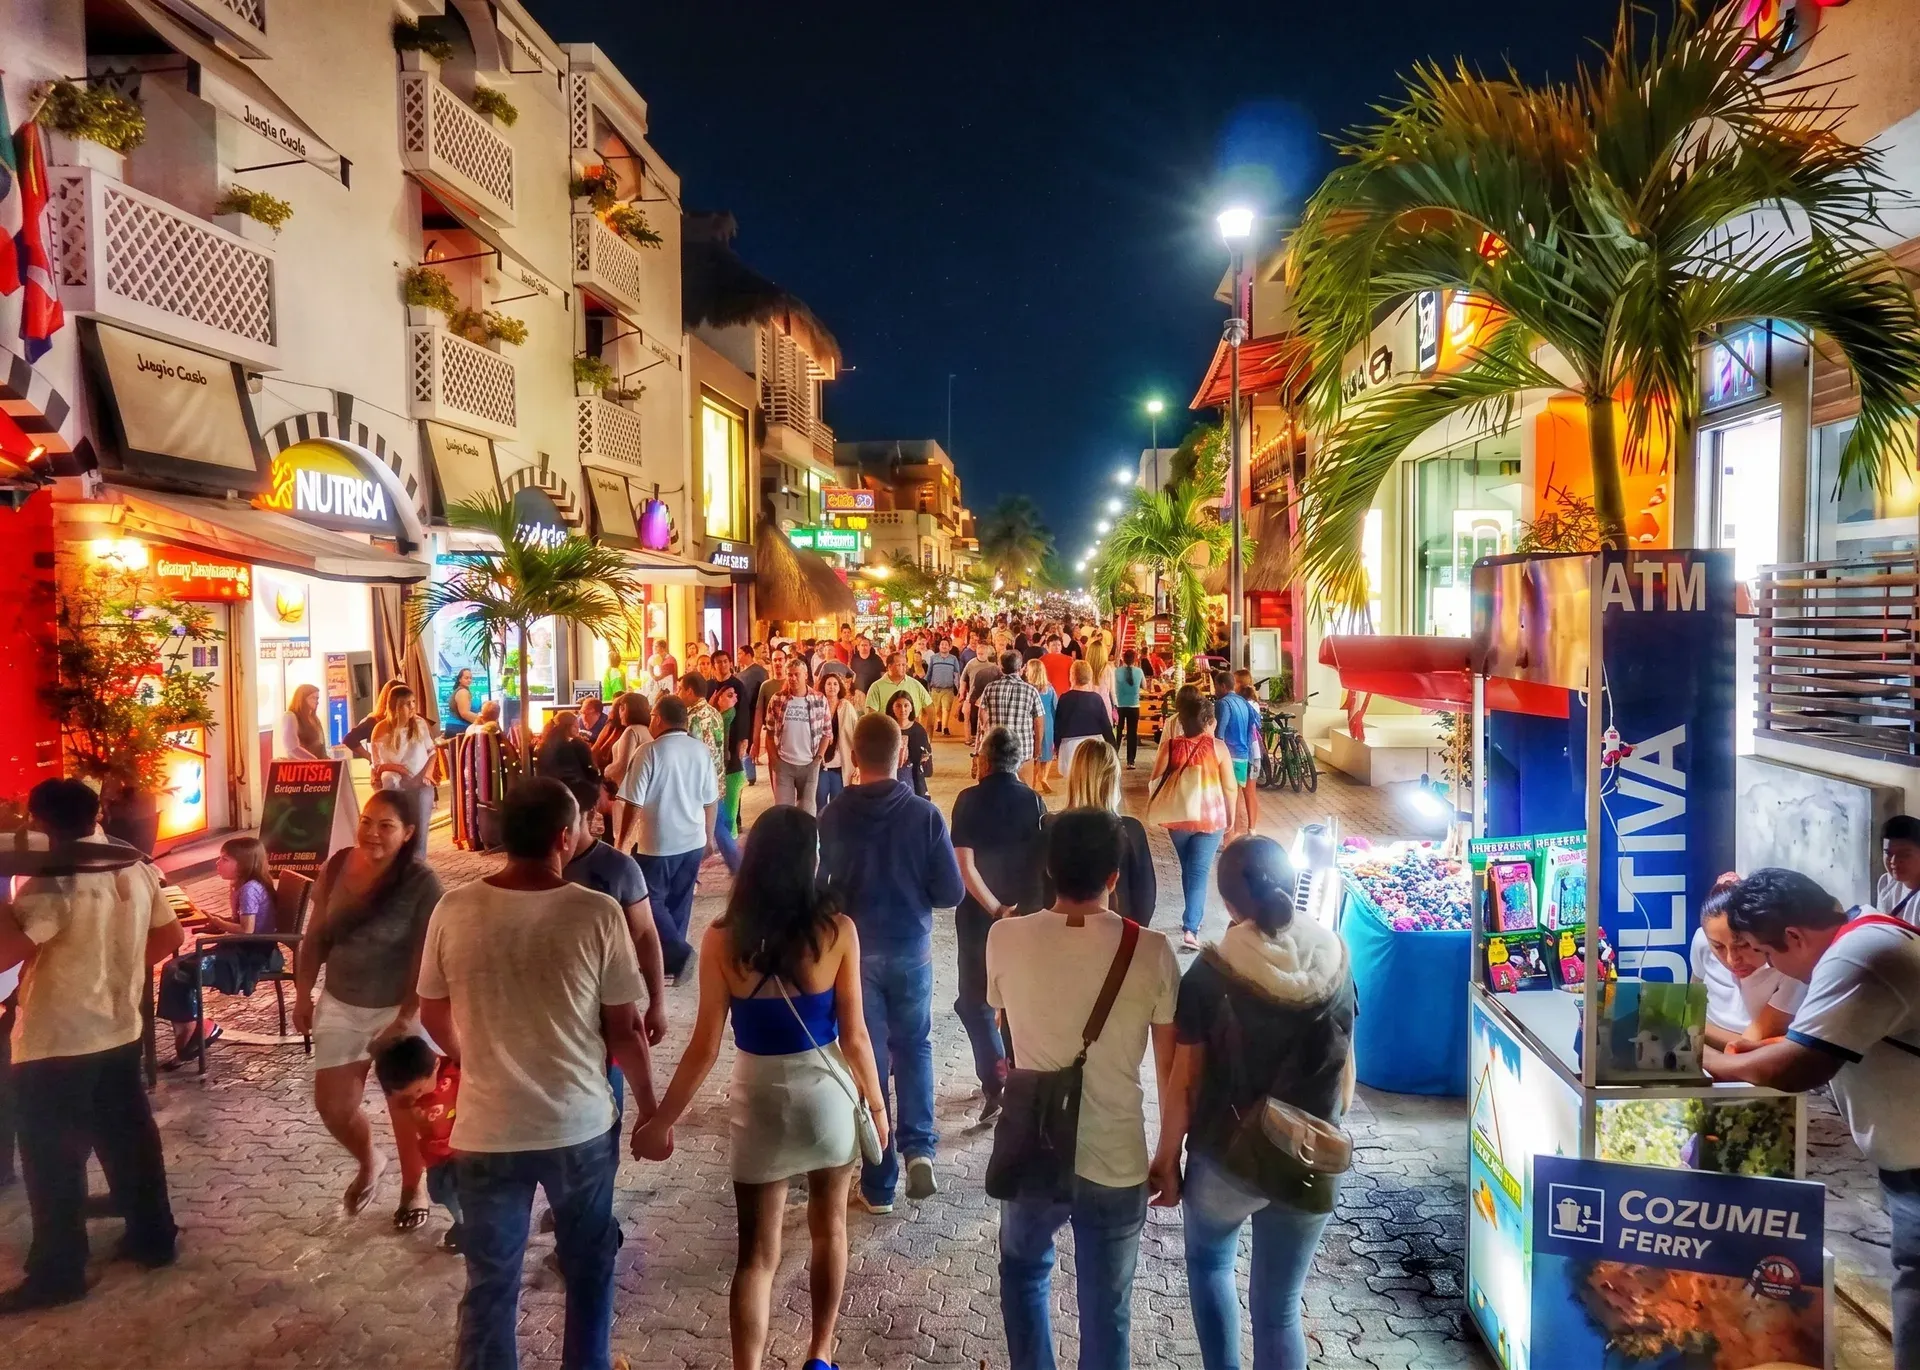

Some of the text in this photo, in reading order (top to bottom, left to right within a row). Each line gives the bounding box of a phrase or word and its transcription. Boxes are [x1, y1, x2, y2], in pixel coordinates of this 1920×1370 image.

[296, 468, 388, 522] NUTRISA
[1601, 561, 1706, 612] ATM
[1618, 1190, 1807, 1241] COZUMEL
[1618, 1227, 1713, 1260] FERRY
